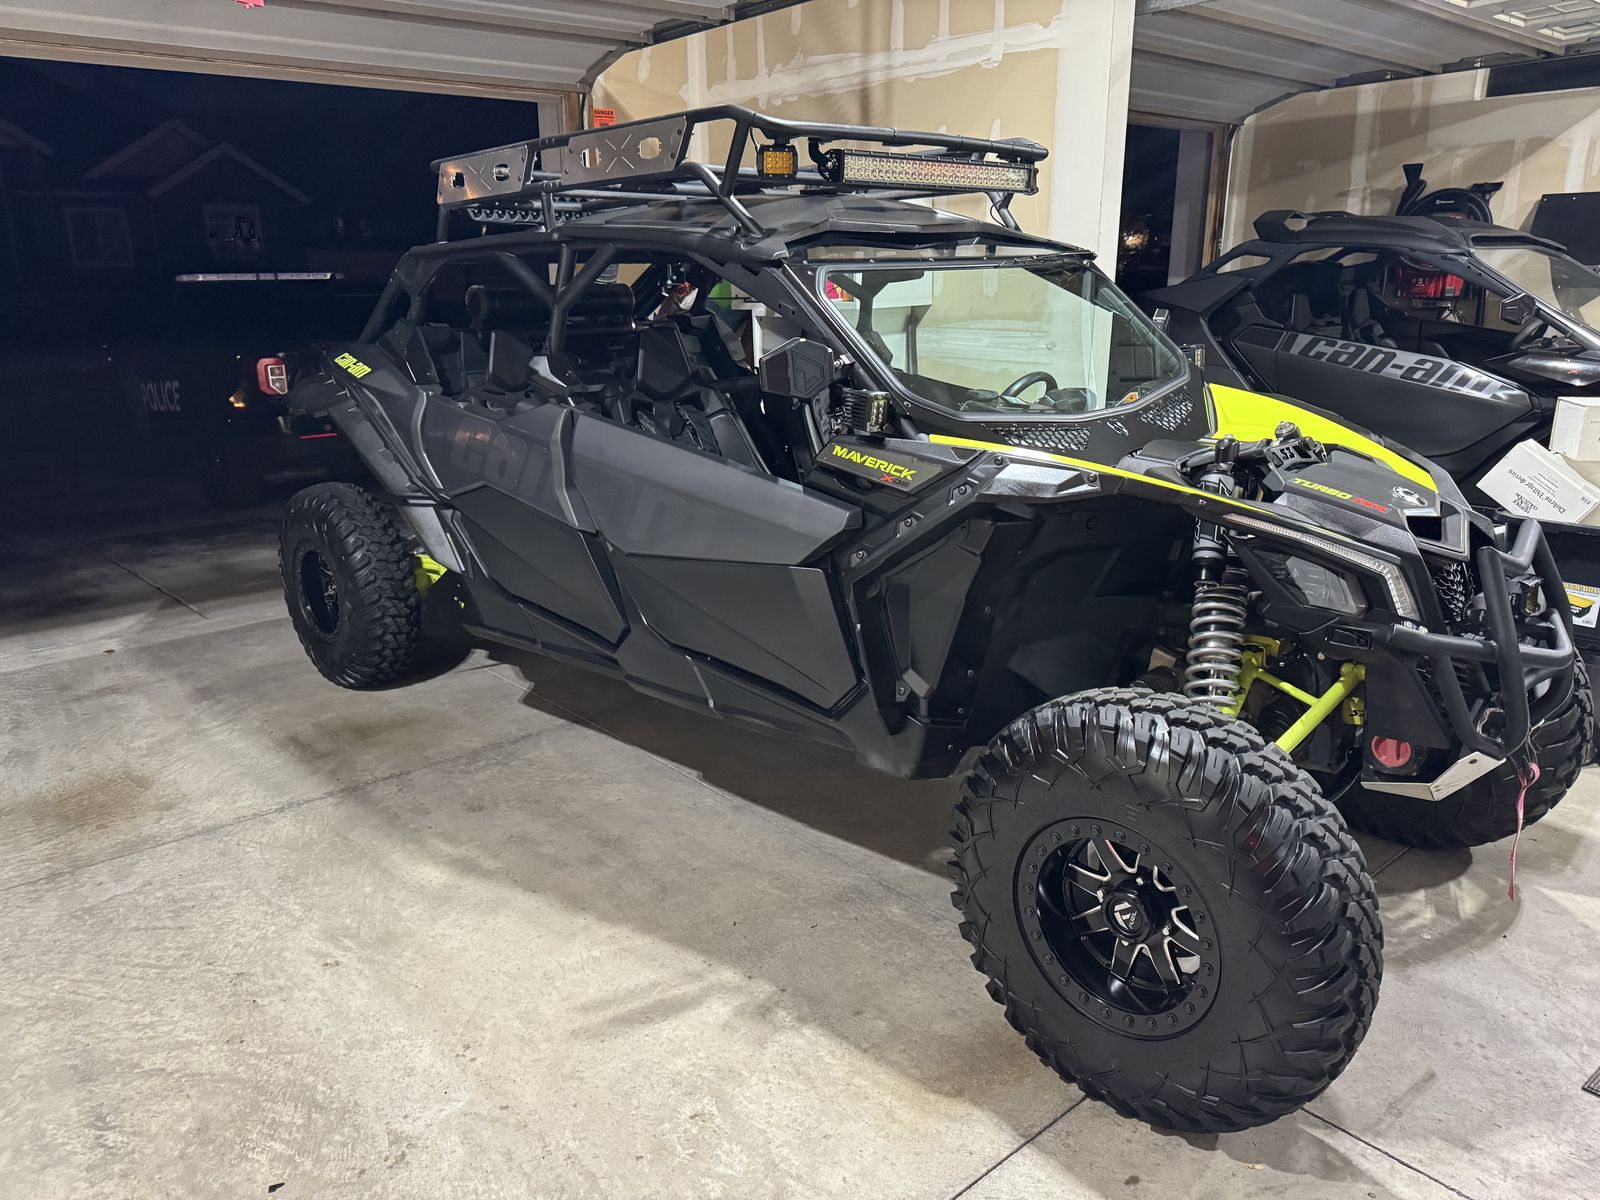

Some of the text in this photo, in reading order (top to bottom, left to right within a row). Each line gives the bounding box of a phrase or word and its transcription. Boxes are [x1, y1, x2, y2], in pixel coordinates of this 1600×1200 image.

[334, 352, 372, 378] can-am
[1298, 336, 1494, 399] can-am
[139, 380, 182, 412] POLICE
[832, 445, 917, 480] MAVERICK
[1294, 478, 1352, 500] TURBO
